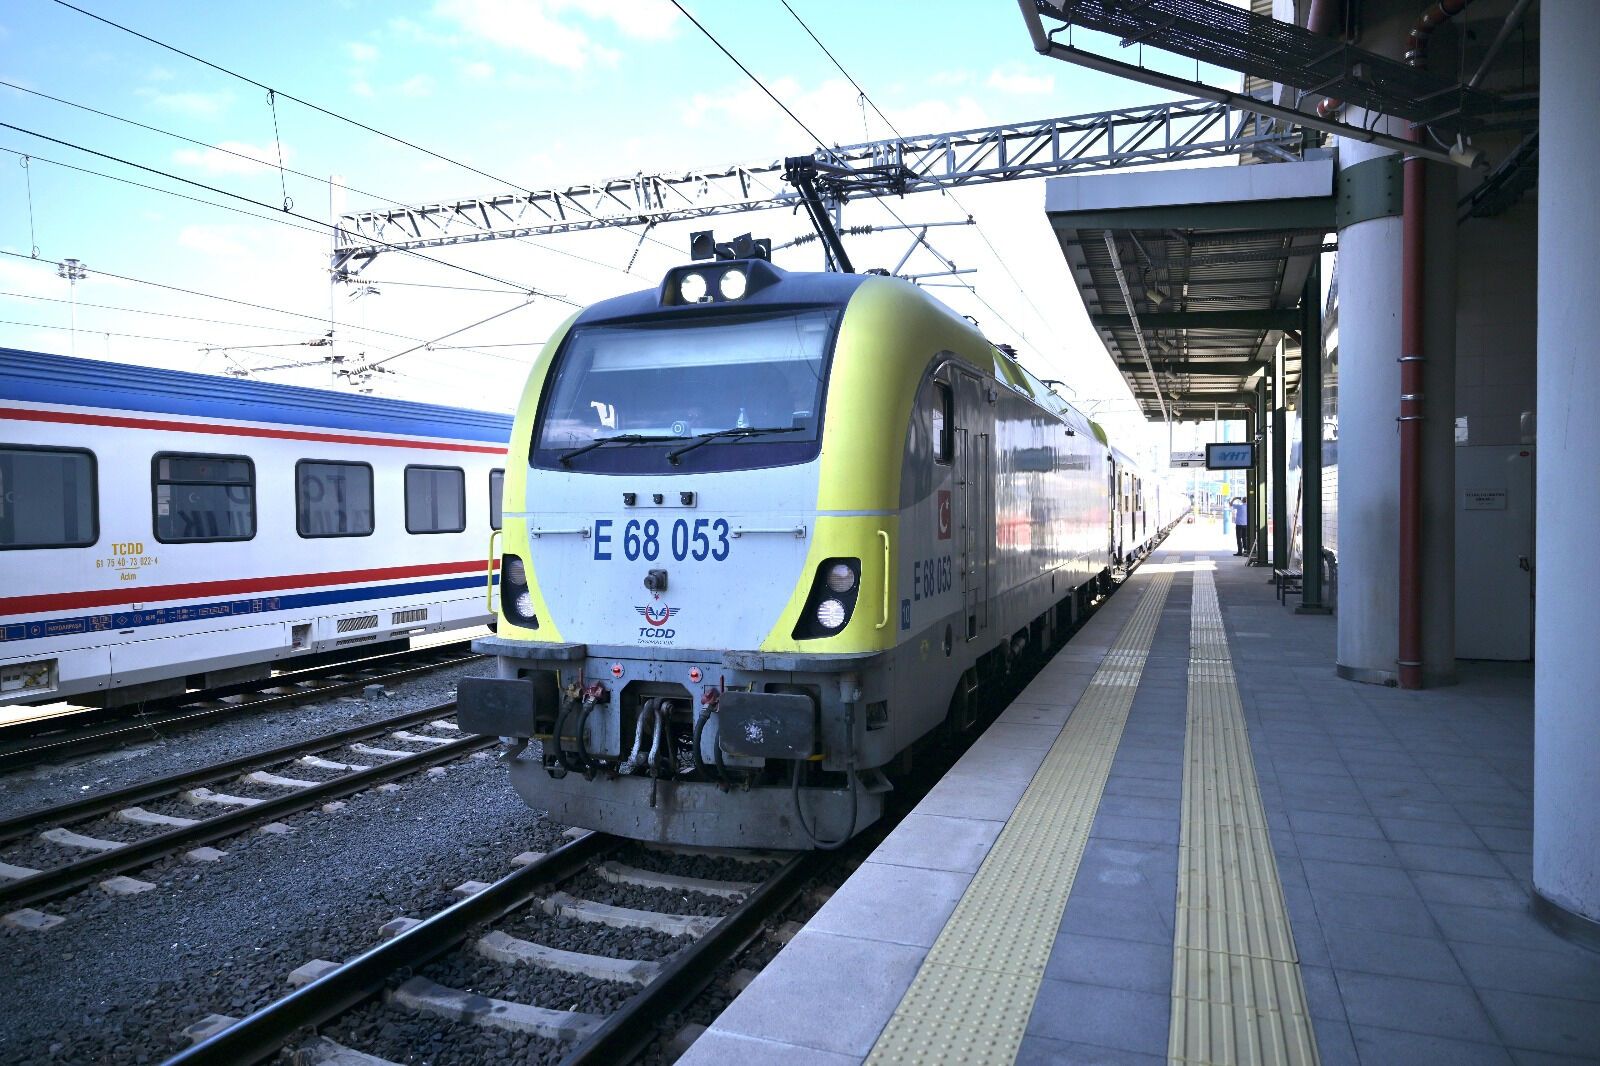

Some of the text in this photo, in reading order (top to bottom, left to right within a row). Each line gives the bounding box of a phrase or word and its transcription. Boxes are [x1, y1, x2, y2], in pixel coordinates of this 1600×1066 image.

[112, 543, 143, 556] TCDD
[594, 518, 730, 562] E 68 053
[914, 555, 951, 601] E 68 053
[639, 628, 676, 639] TCDD
